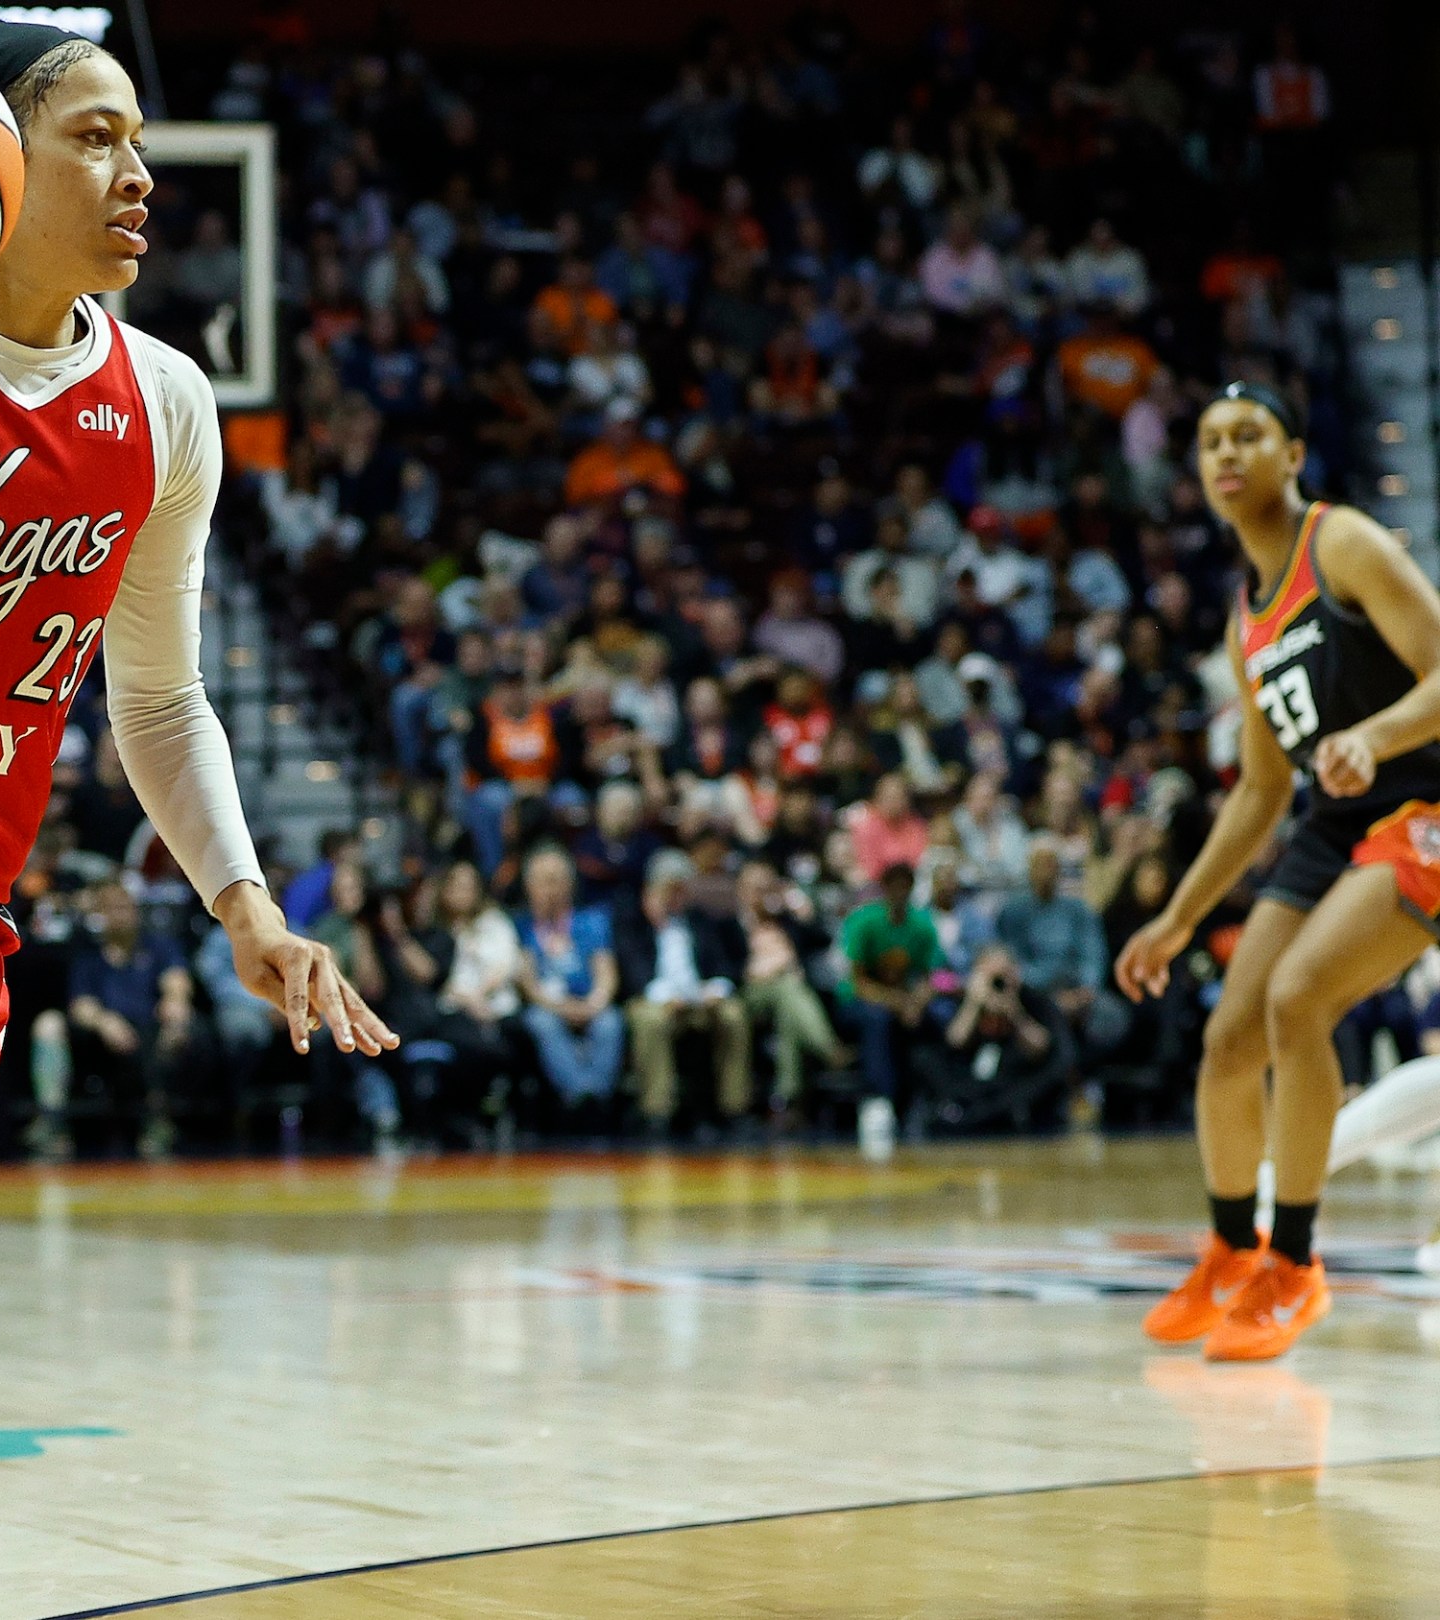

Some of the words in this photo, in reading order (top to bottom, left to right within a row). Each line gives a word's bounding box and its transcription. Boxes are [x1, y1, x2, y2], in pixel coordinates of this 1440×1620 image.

[77, 403, 130, 441] ally
[8, 612, 104, 704] 23
[1254, 664, 1320, 752] 33
